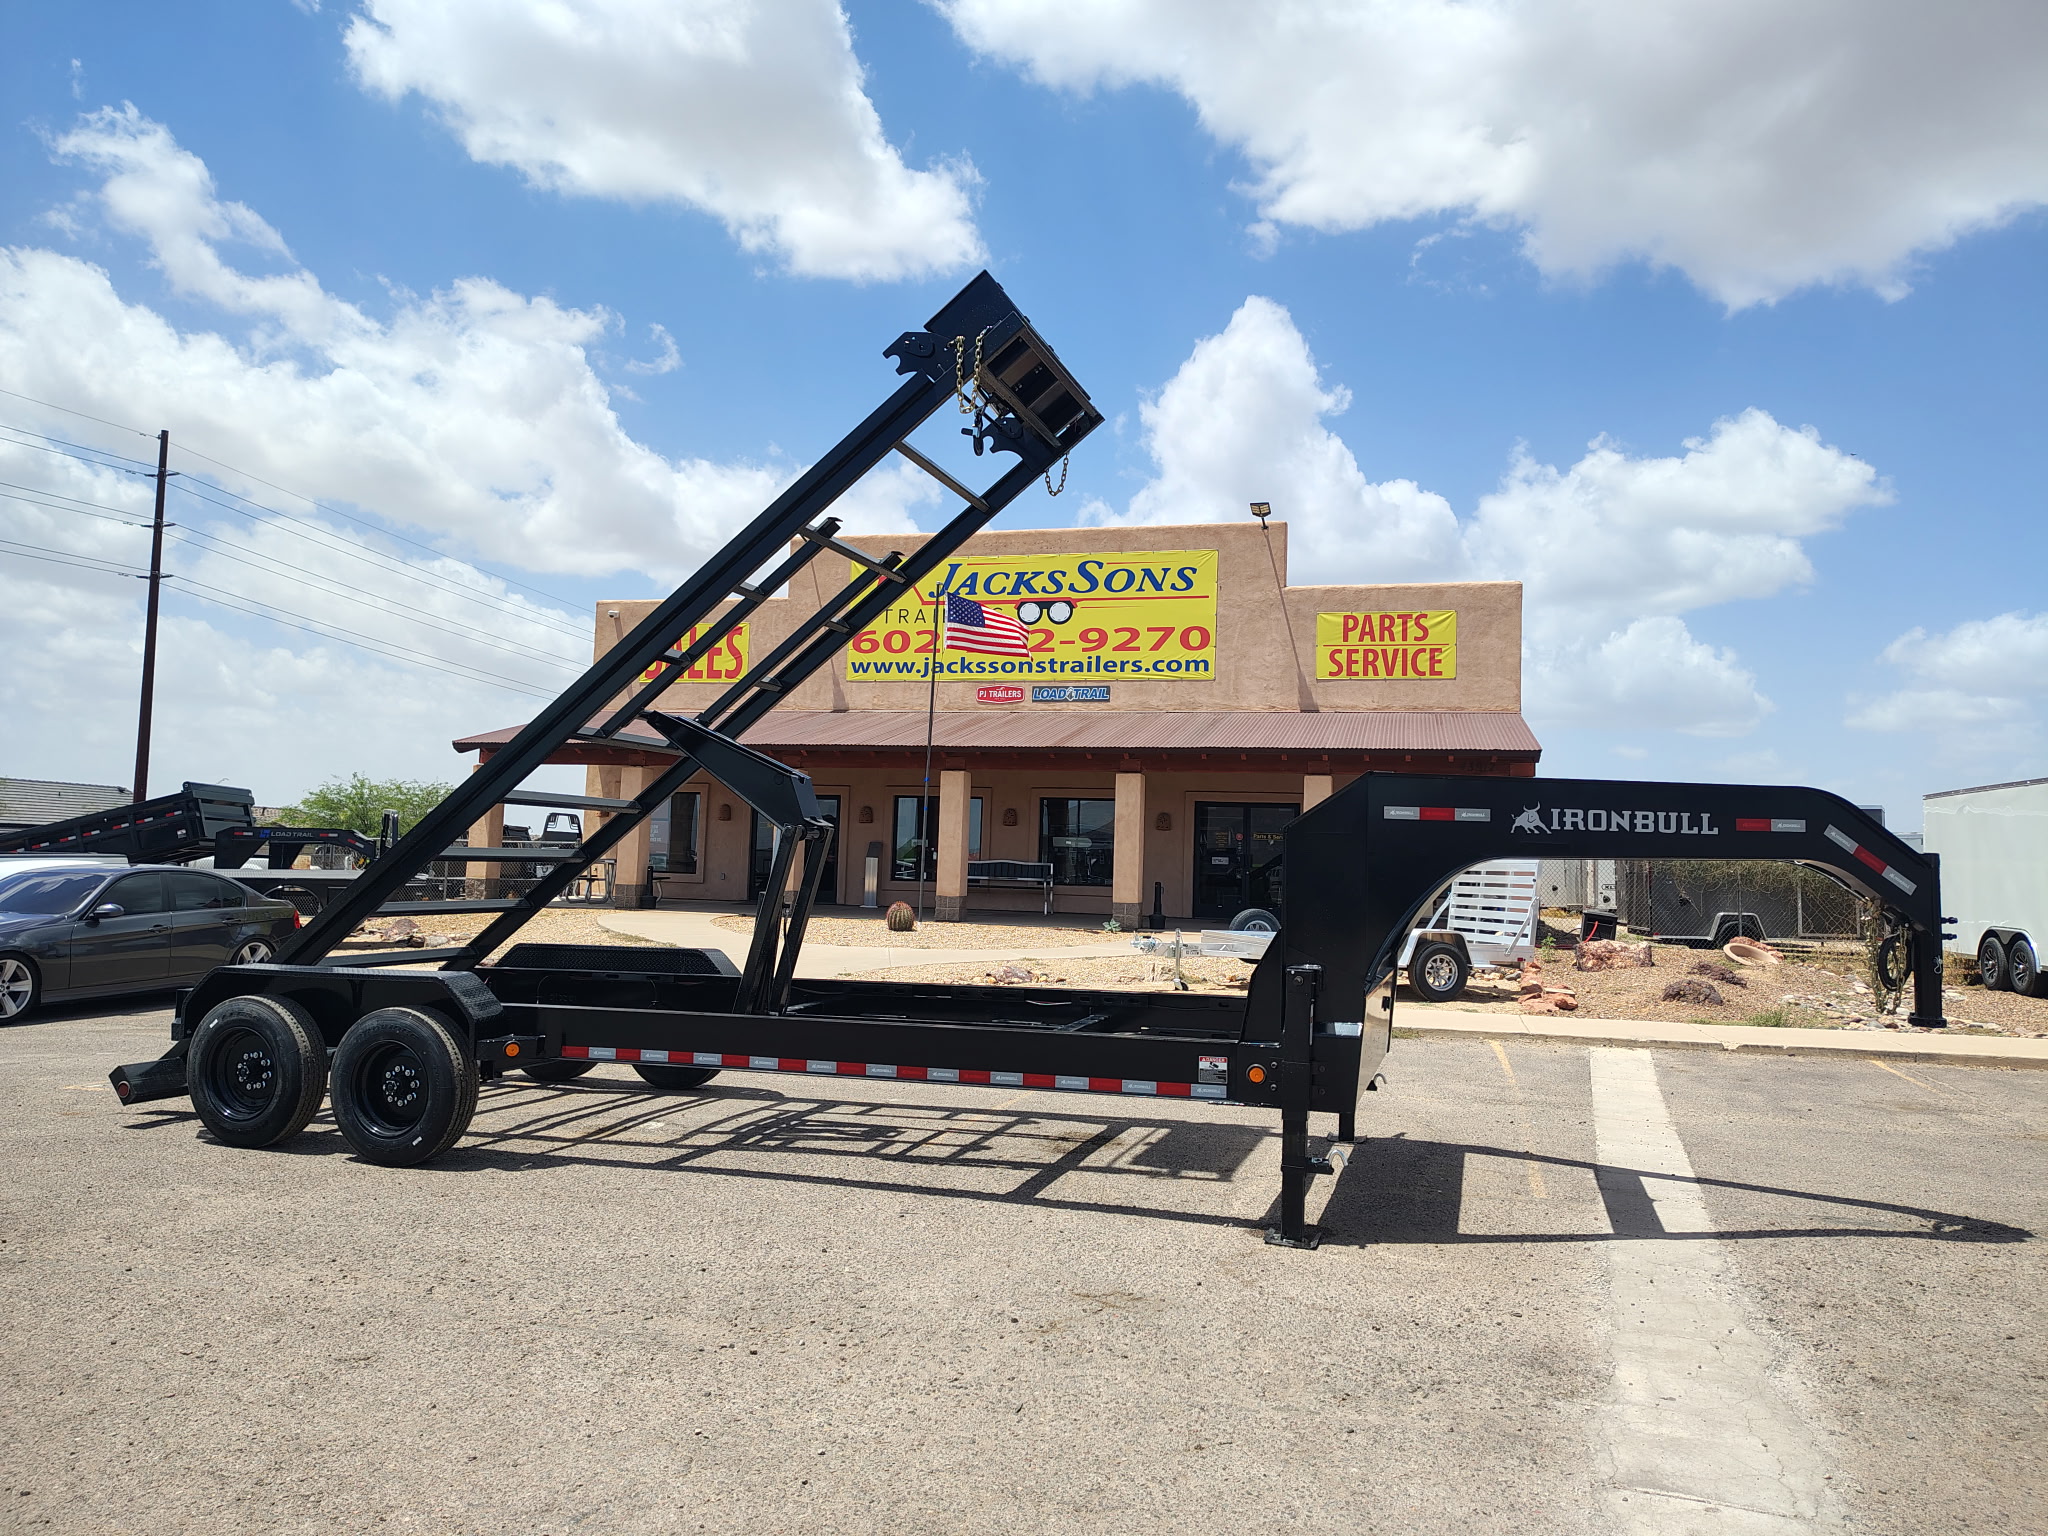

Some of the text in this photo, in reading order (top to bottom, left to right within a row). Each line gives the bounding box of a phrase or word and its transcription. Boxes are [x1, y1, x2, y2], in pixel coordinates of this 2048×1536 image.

[1342, 613, 1430, 643] PARTS
[851, 656, 1210, 678] www.jackssonstrailers.com
[1328, 648, 1443, 677] SERVICE
[979, 689, 1022, 698] PJ TRAILERS
[1033, 688, 1109, 700] LOAD TRAIL
[1550, 808, 1719, 835] IRONBULL
